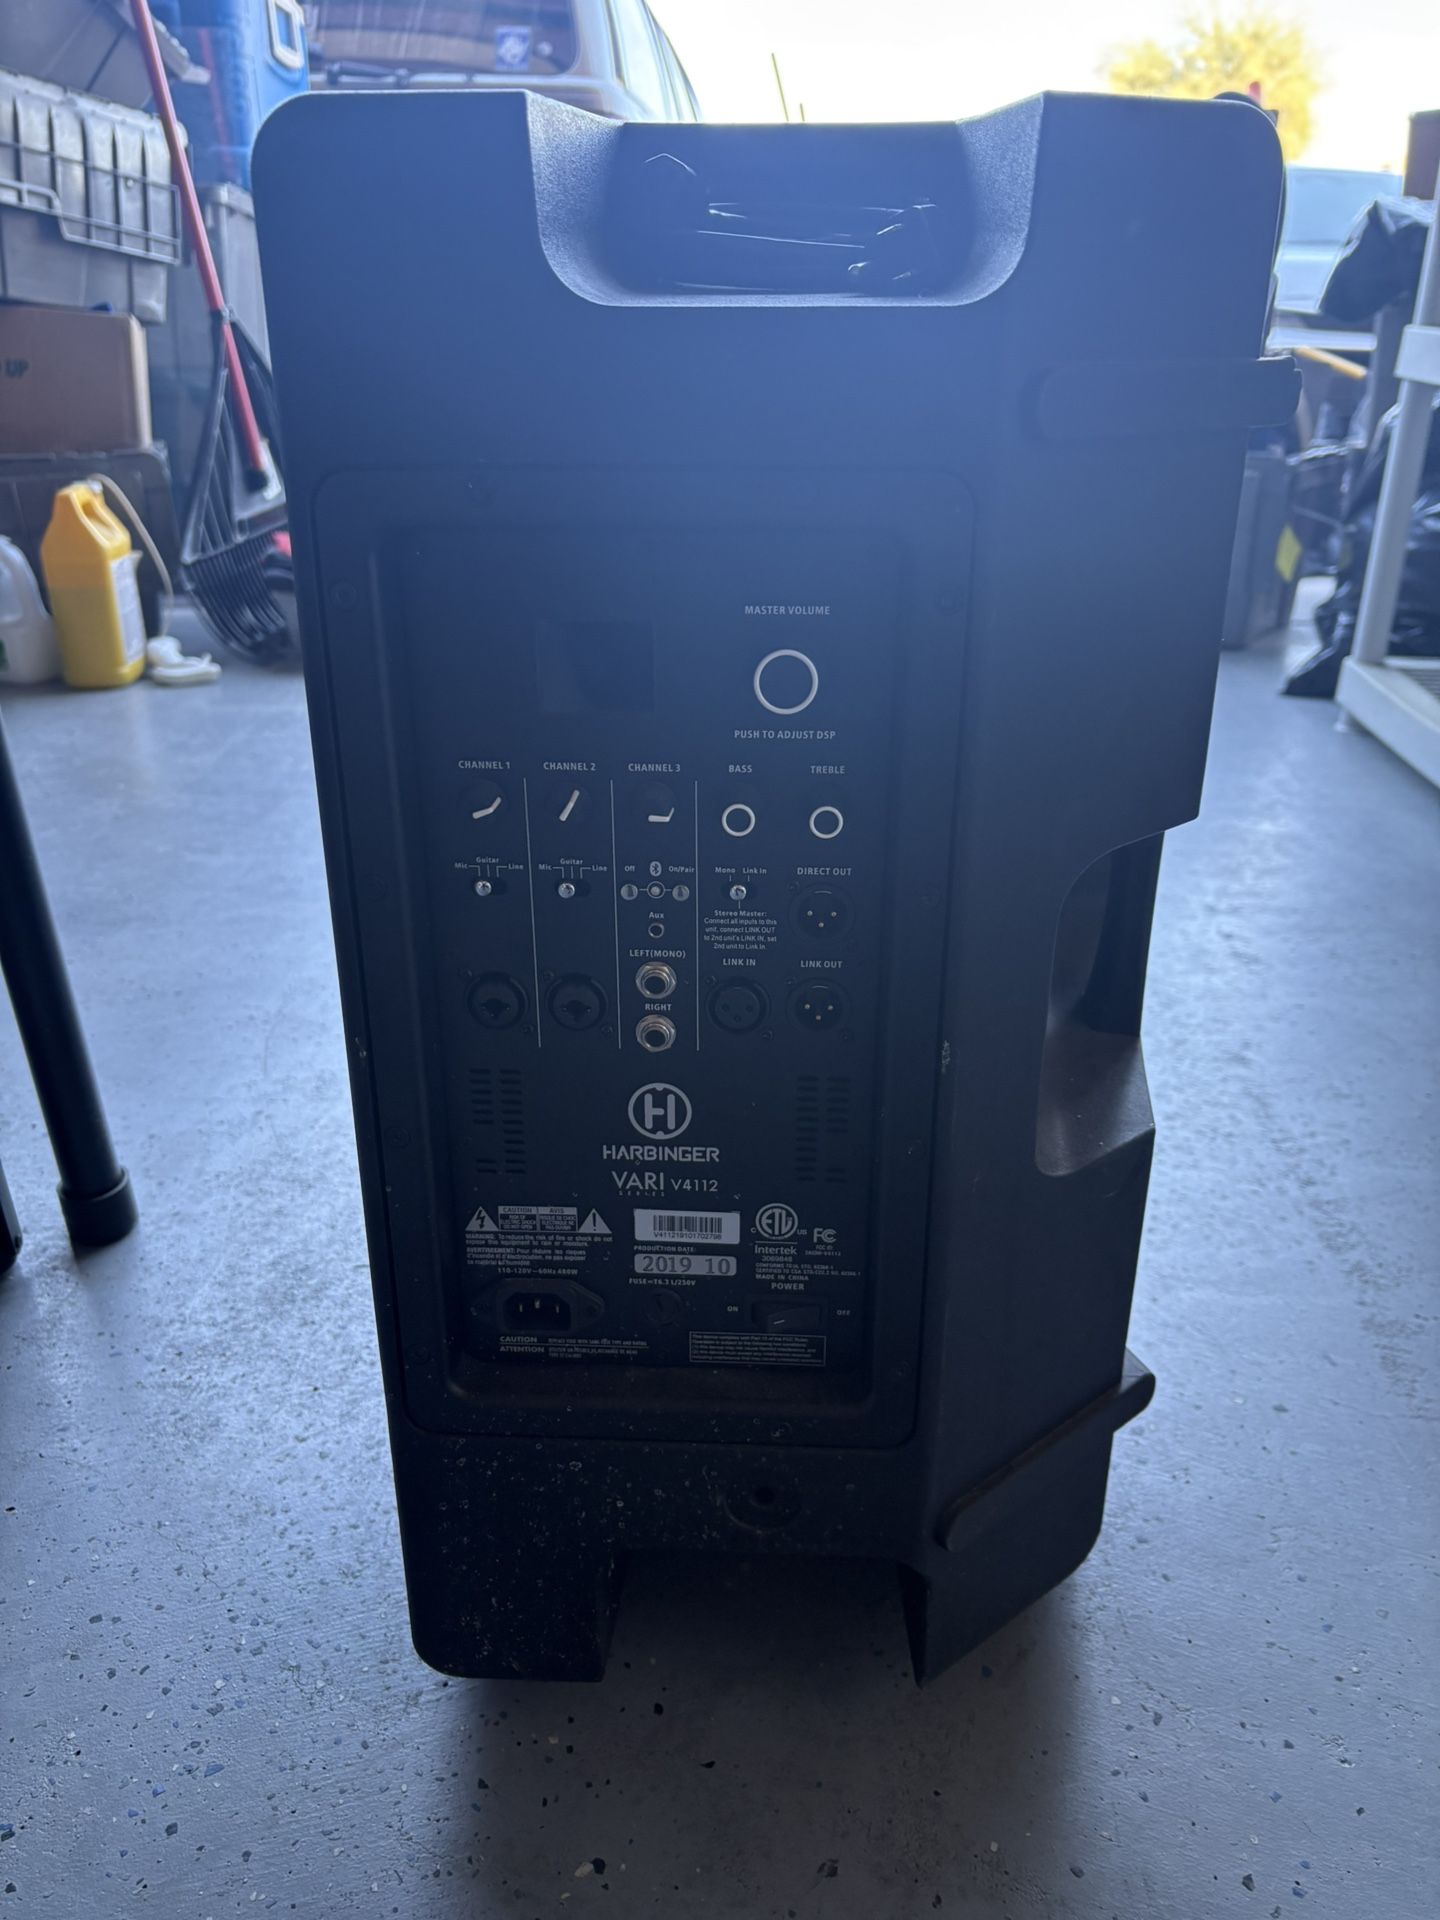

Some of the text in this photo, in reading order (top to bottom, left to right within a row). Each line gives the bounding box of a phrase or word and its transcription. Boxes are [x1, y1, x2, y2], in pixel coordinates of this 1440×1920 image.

[5, 358, 29, 379] UP
[744, 605, 831, 615] MASTER VOLUME
[734, 729, 836, 740] PUSH TO ADJUST DSP
[458, 760, 511, 770] CHANNEL 1
[543, 761, 597, 772] CHANNEL 2
[627, 762, 682, 773] CHANNEL 3
[728, 764, 753, 774] BASS
[810, 765, 846, 775] TREBLE
[476, 856, 500, 865] Guitar
[559, 857, 584, 866] Guitar
[454, 862, 524, 871] Mic Line
[538, 863, 553, 871] Mic
[624, 865, 696, 874] Off On/Pair
[714, 866, 737, 874] Mono
[742, 866, 758, 874] Link
[797, 867, 853, 877] DIRECT OUT
[648, 911, 665, 919] Aux
[714, 909, 768, 918] Stereo Master:
[704, 917, 730, 925] Connect
[739, 918, 758, 926] inputs
[761, 926, 776, 934] OUT
[713, 942, 725, 950] 2nd
[629, 948, 687, 958] LEFT(MONO)
[722, 958, 757, 968] LINK IN
[800, 960, 843, 971] LINK OUT
[644, 1002, 673, 1012] RIGHT
[602, 1145, 720, 1162] HARBINGER
[611, 1170, 719, 1192] VARI V4112
[754, 1244, 799, 1256] Intertek
[642, 1255, 731, 1275] 2019 10
[770, 1282, 805, 1291] POWER
[726, 1304, 740, 1313] ON
[499, 1335, 538, 1343] CAUTION
[499, 1345, 545, 1353] ATTENTION
